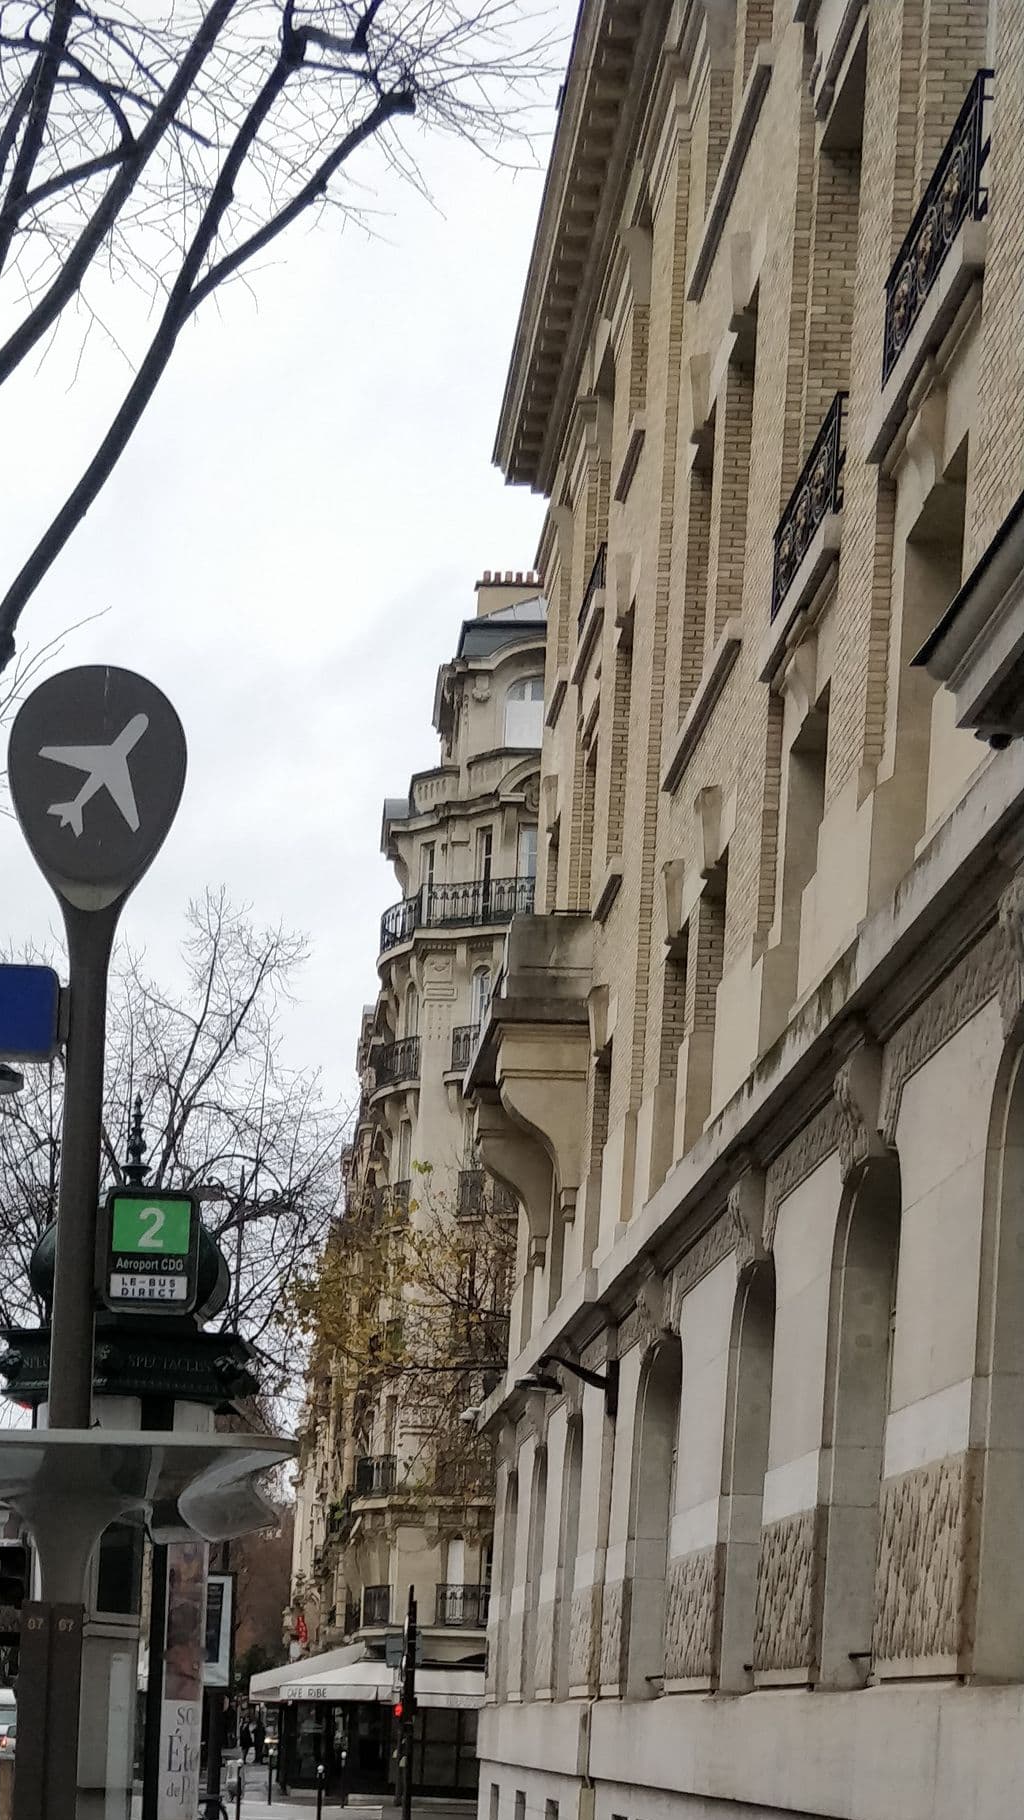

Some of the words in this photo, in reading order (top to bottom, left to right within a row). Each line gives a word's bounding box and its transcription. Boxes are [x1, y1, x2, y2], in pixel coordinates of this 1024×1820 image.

[137, 1207, 166, 1248] 2
[161, 1258, 184, 1271] CDG
[121, 1287, 176, 1298] DIRECT
